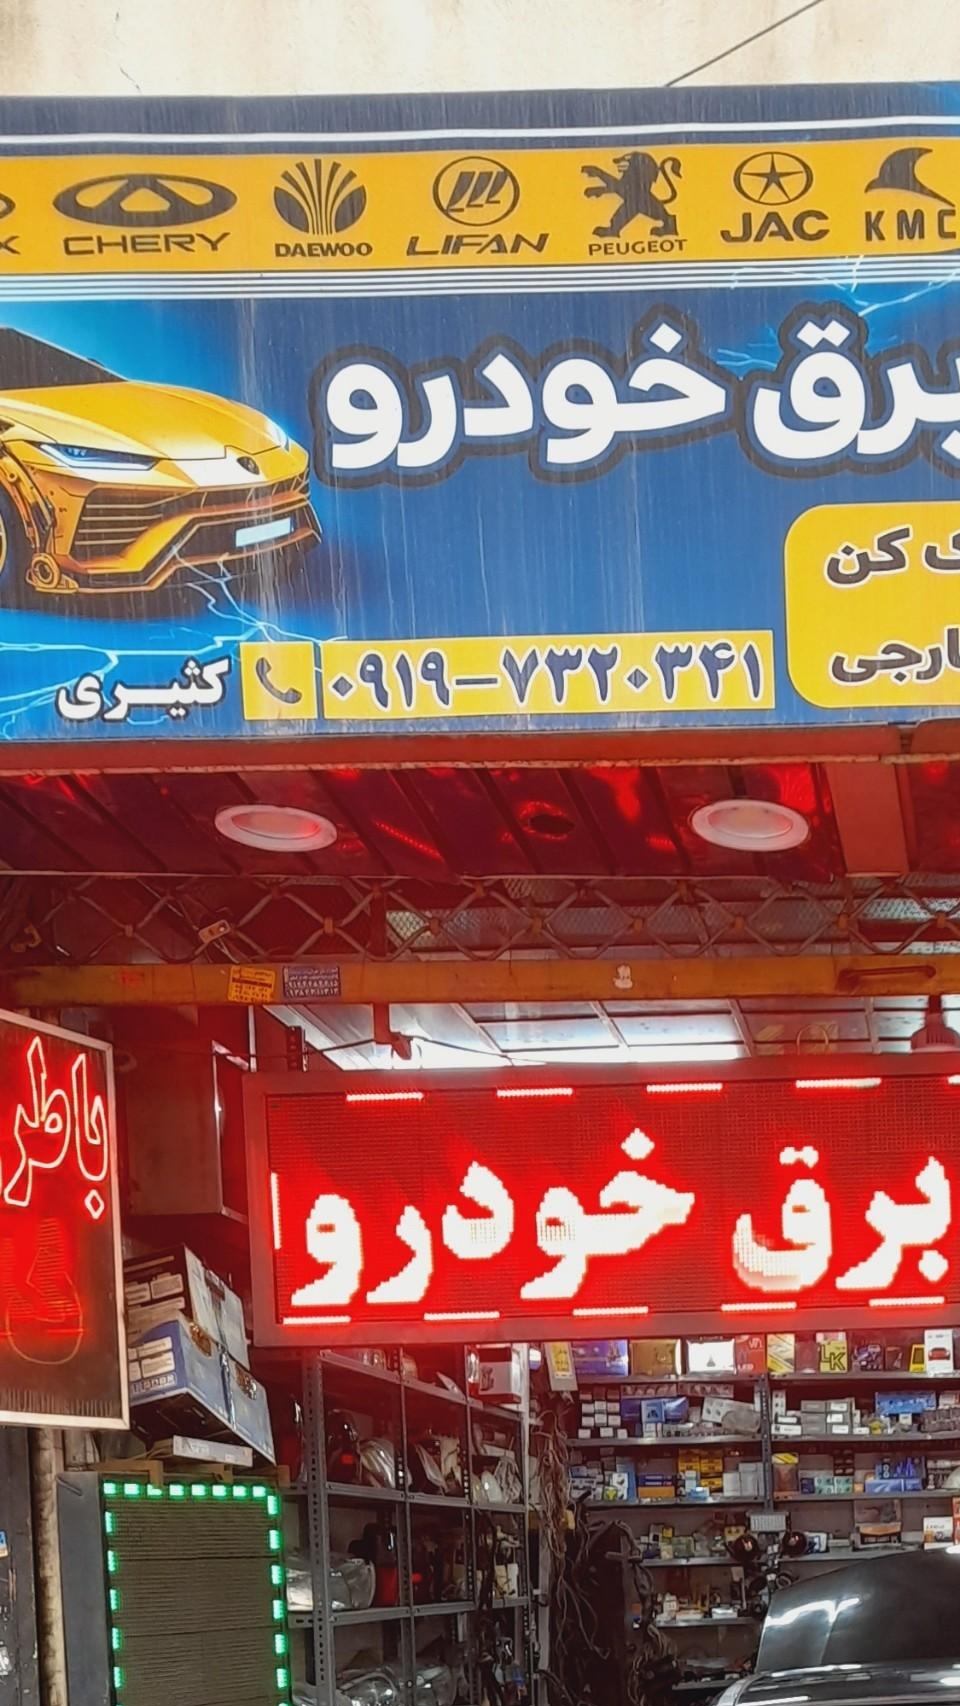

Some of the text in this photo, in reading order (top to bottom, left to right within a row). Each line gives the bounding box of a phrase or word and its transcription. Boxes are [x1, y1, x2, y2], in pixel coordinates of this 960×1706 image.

[63, 232, 229, 256] CHERY
[406, 233, 549, 256] LIFAN
[588, 238, 687, 256] PEUGEOT
[720, 209, 829, 243] JAC
[866, 208, 956, 241] KMC
[274, 242, 373, 257] DAEWOO
[326, 323, 726, 469] خودرو
[826, 527, 910, 585] کن
[57, 659, 229, 719] کثیری
[0, 1035, 109, 1219] باطر
[291, 1129, 694, 1305] خودرو
[733, 1146, 951, 1291] برق
